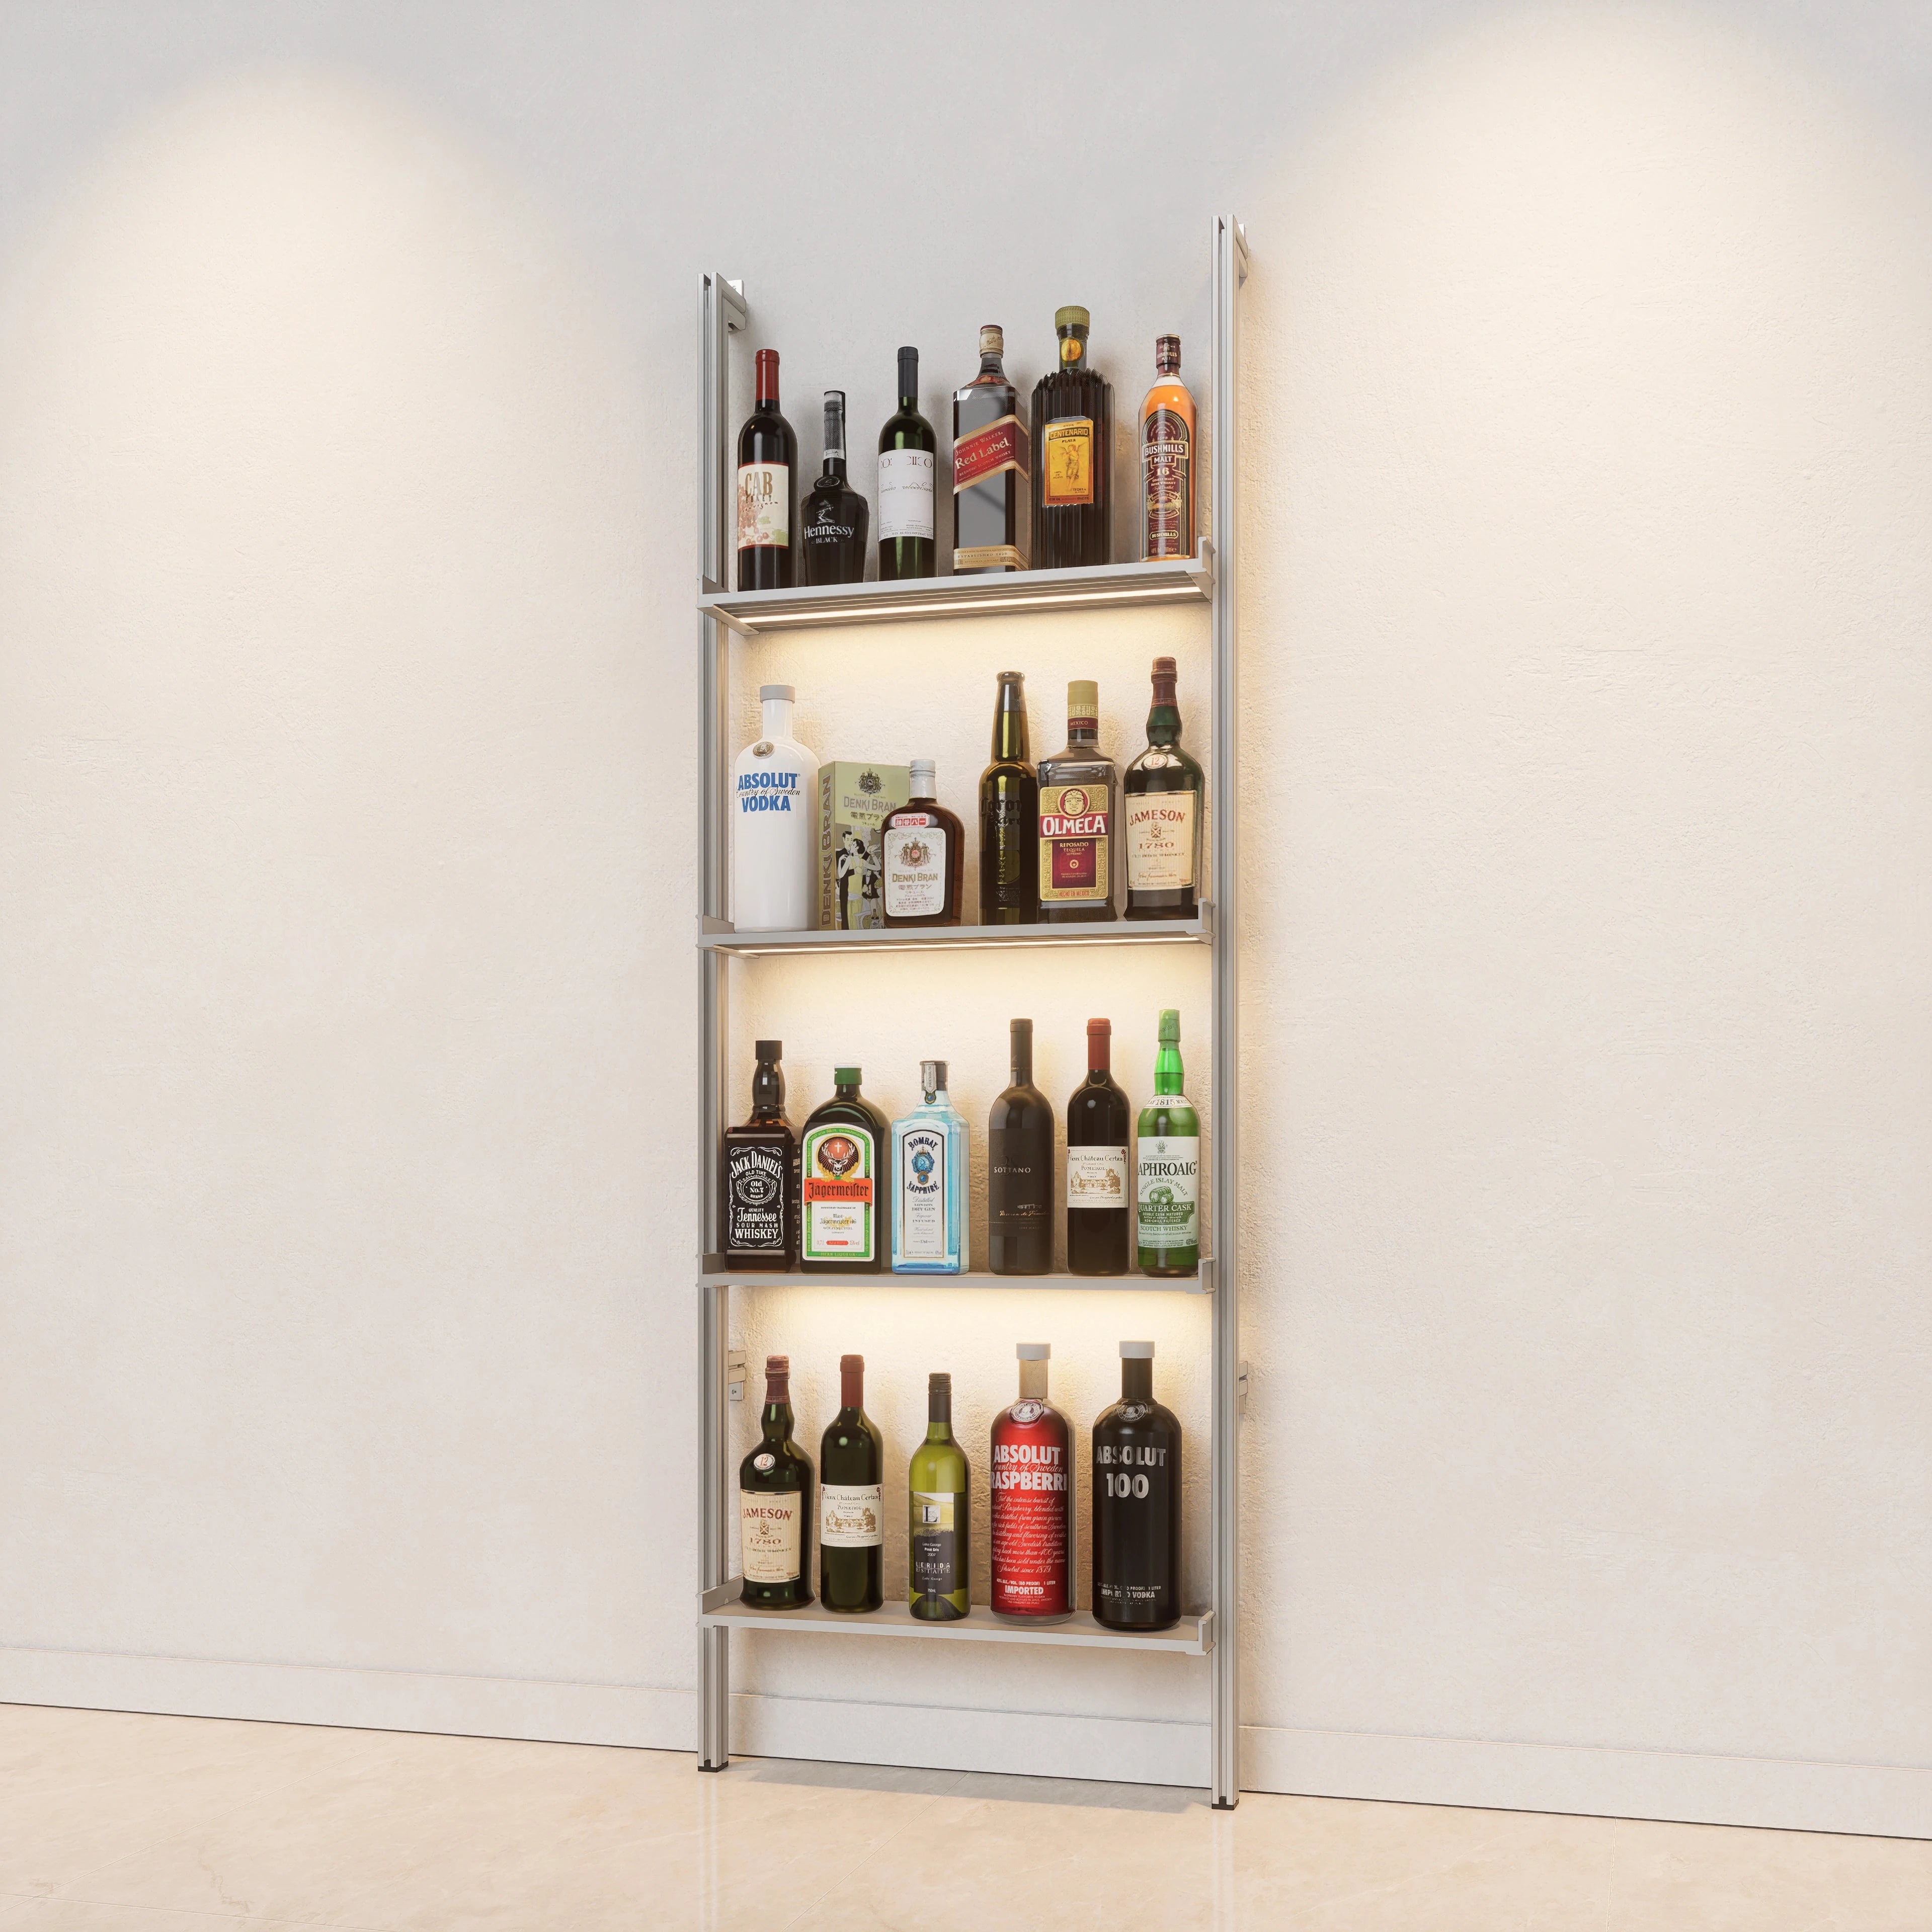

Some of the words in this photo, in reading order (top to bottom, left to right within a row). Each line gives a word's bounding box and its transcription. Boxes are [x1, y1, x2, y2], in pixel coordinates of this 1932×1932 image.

[1050, 428, 1089, 439] CENTENARIO
[956, 442, 979, 456] JOHNNIE
[1145, 444, 1183, 456] BUSHMILLS
[955, 452, 978, 470] Red
[1157, 467, 1170, 476] 16
[745, 471, 773, 497] CAB
[804, 526, 854, 539] Hennessy
[1151, 756, 1160, 766] 12
[738, 772, 798, 790] ABSOLUT
[736, 786, 759, 799] Country
[761, 786, 769, 798] of
[769, 786, 801, 796] Sweden
[742, 795, 791, 813] VODKA
[844, 796, 869, 811] DENKI
[872, 799, 896, 812] BRAN
[822, 773, 832, 851] BRAN
[1130, 809, 1185, 826] JAMESON
[1042, 815, 1105, 836] OLMECA
[1139, 841, 1174, 849] 1780
[892, 873, 916, 883] DENKI
[917, 873, 938, 881] BRAN
[822, 852, 832, 927] DENKI
[908, 1137, 938, 1151] BOMBAY
[730, 1156, 751, 1178] JACK
[751, 1151, 783, 1179] DANIEL'S
[1138, 1162, 1196, 1176] APHROAIG
[907, 1181, 939, 1194] SAPPHIRE
[1140, 1179, 1155, 1196] SINGLE
[1174, 1182, 1188, 1196] MALT
[737, 1208, 776, 1222] Tennessee
[1138, 1204, 1169, 1213] QUARTER
[735, 1229, 778, 1239] WHISKEY
[760, 1457, 768, 1466] 12
[994, 1445, 1061, 1465] ABSOLUT
[1096, 1446, 1166, 1467] ABSOLUT
[992, 1461, 1017, 1473] Country
[1019, 1462, 1031, 1473] of
[1030, 1462, 1063, 1473] Sweden
[991, 1471, 1067, 1491] RASPBERRI
[1106, 1473, 1149, 1499] 100
[1048, 1497, 1056, 1506] of
[743, 1508, 792, 1521] JAMESON
[1018, 1514, 1031, 1523] from
[1032, 1515, 1047, 1523] grain
[1018, 1523, 1025, 1532] of
[1022, 1532, 1048, 1541] flavoring
[997, 1563, 1020, 1572] Absolut
[1005, 1585, 1043, 1595] IMPORTED
